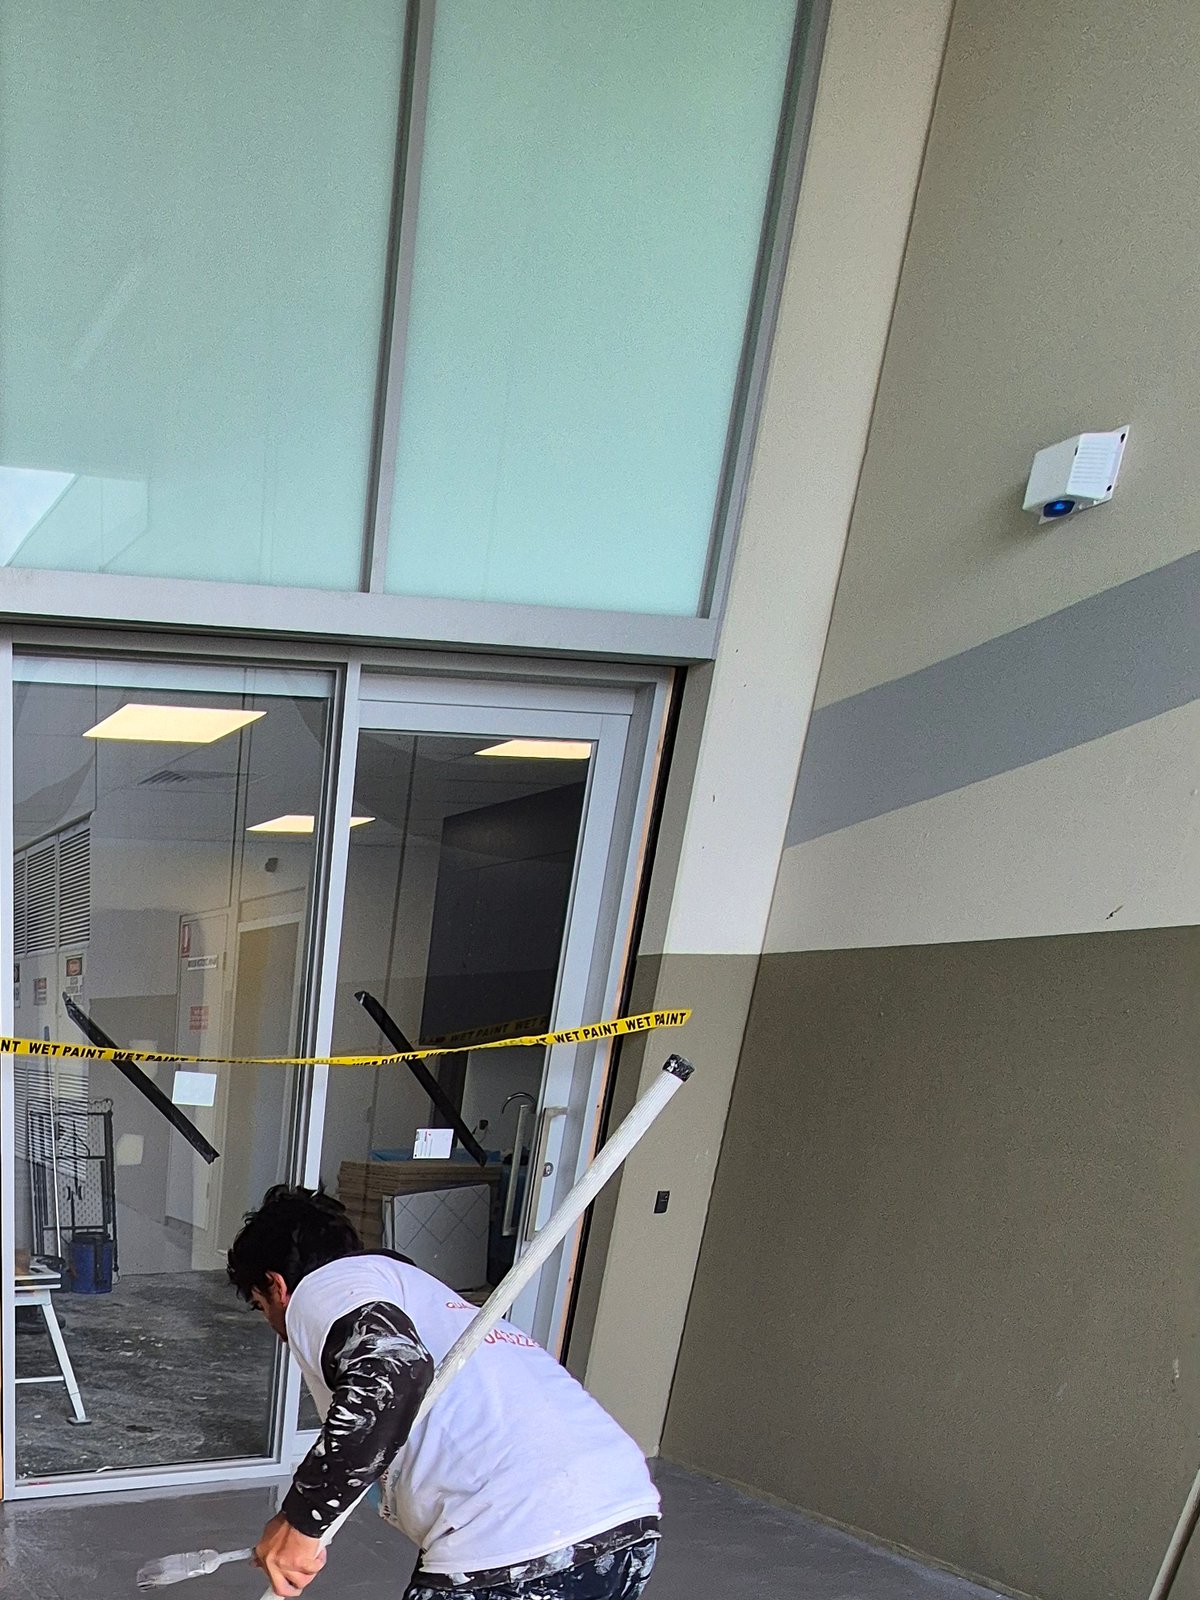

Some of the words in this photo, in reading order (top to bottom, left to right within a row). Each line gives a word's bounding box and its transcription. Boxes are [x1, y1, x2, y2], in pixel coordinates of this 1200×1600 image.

[29, 1042, 60, 1055] WET
[62, 1046, 106, 1059] PAINT
[113, 1051, 144, 1061] WET
[554, 1031, 581, 1044] WET
[583, 1023, 618, 1039] PAINT
[625, 1016, 651, 1031] WET
[654, 1012, 687, 1026] PAINT
